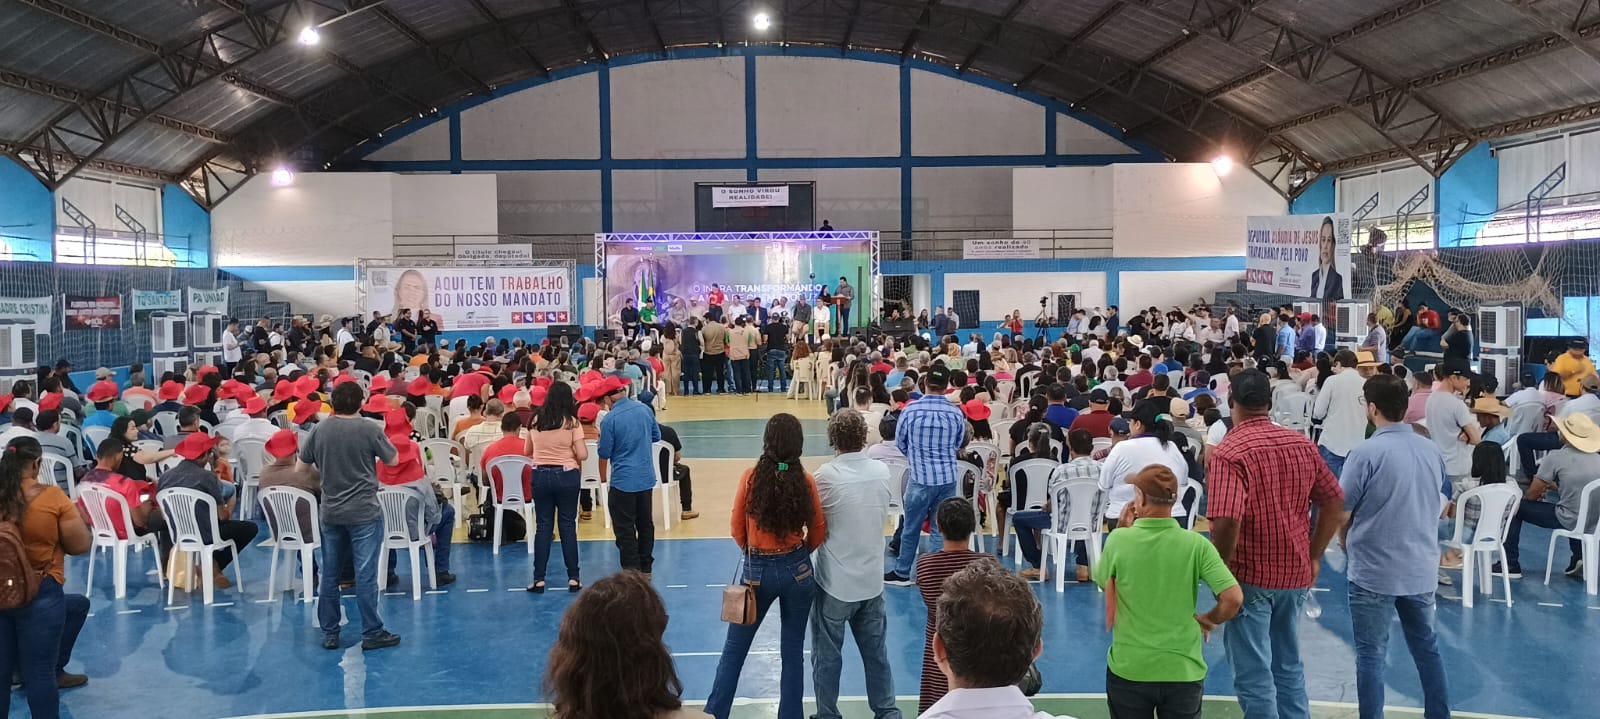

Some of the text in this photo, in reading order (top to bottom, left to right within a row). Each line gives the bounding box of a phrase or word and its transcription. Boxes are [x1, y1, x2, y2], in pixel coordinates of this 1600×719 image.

[1294, 230, 1300, 244] DE
[1302, 230, 1318, 244] JESUS
[1280, 248, 1292, 261] PELO
[435, 276, 563, 290] AQUI TEM TRABALHO
[693, 284, 823, 293] O INRA TRANSFORMANDO
[435, 292, 561, 307] DO NOSSO MANDATO
